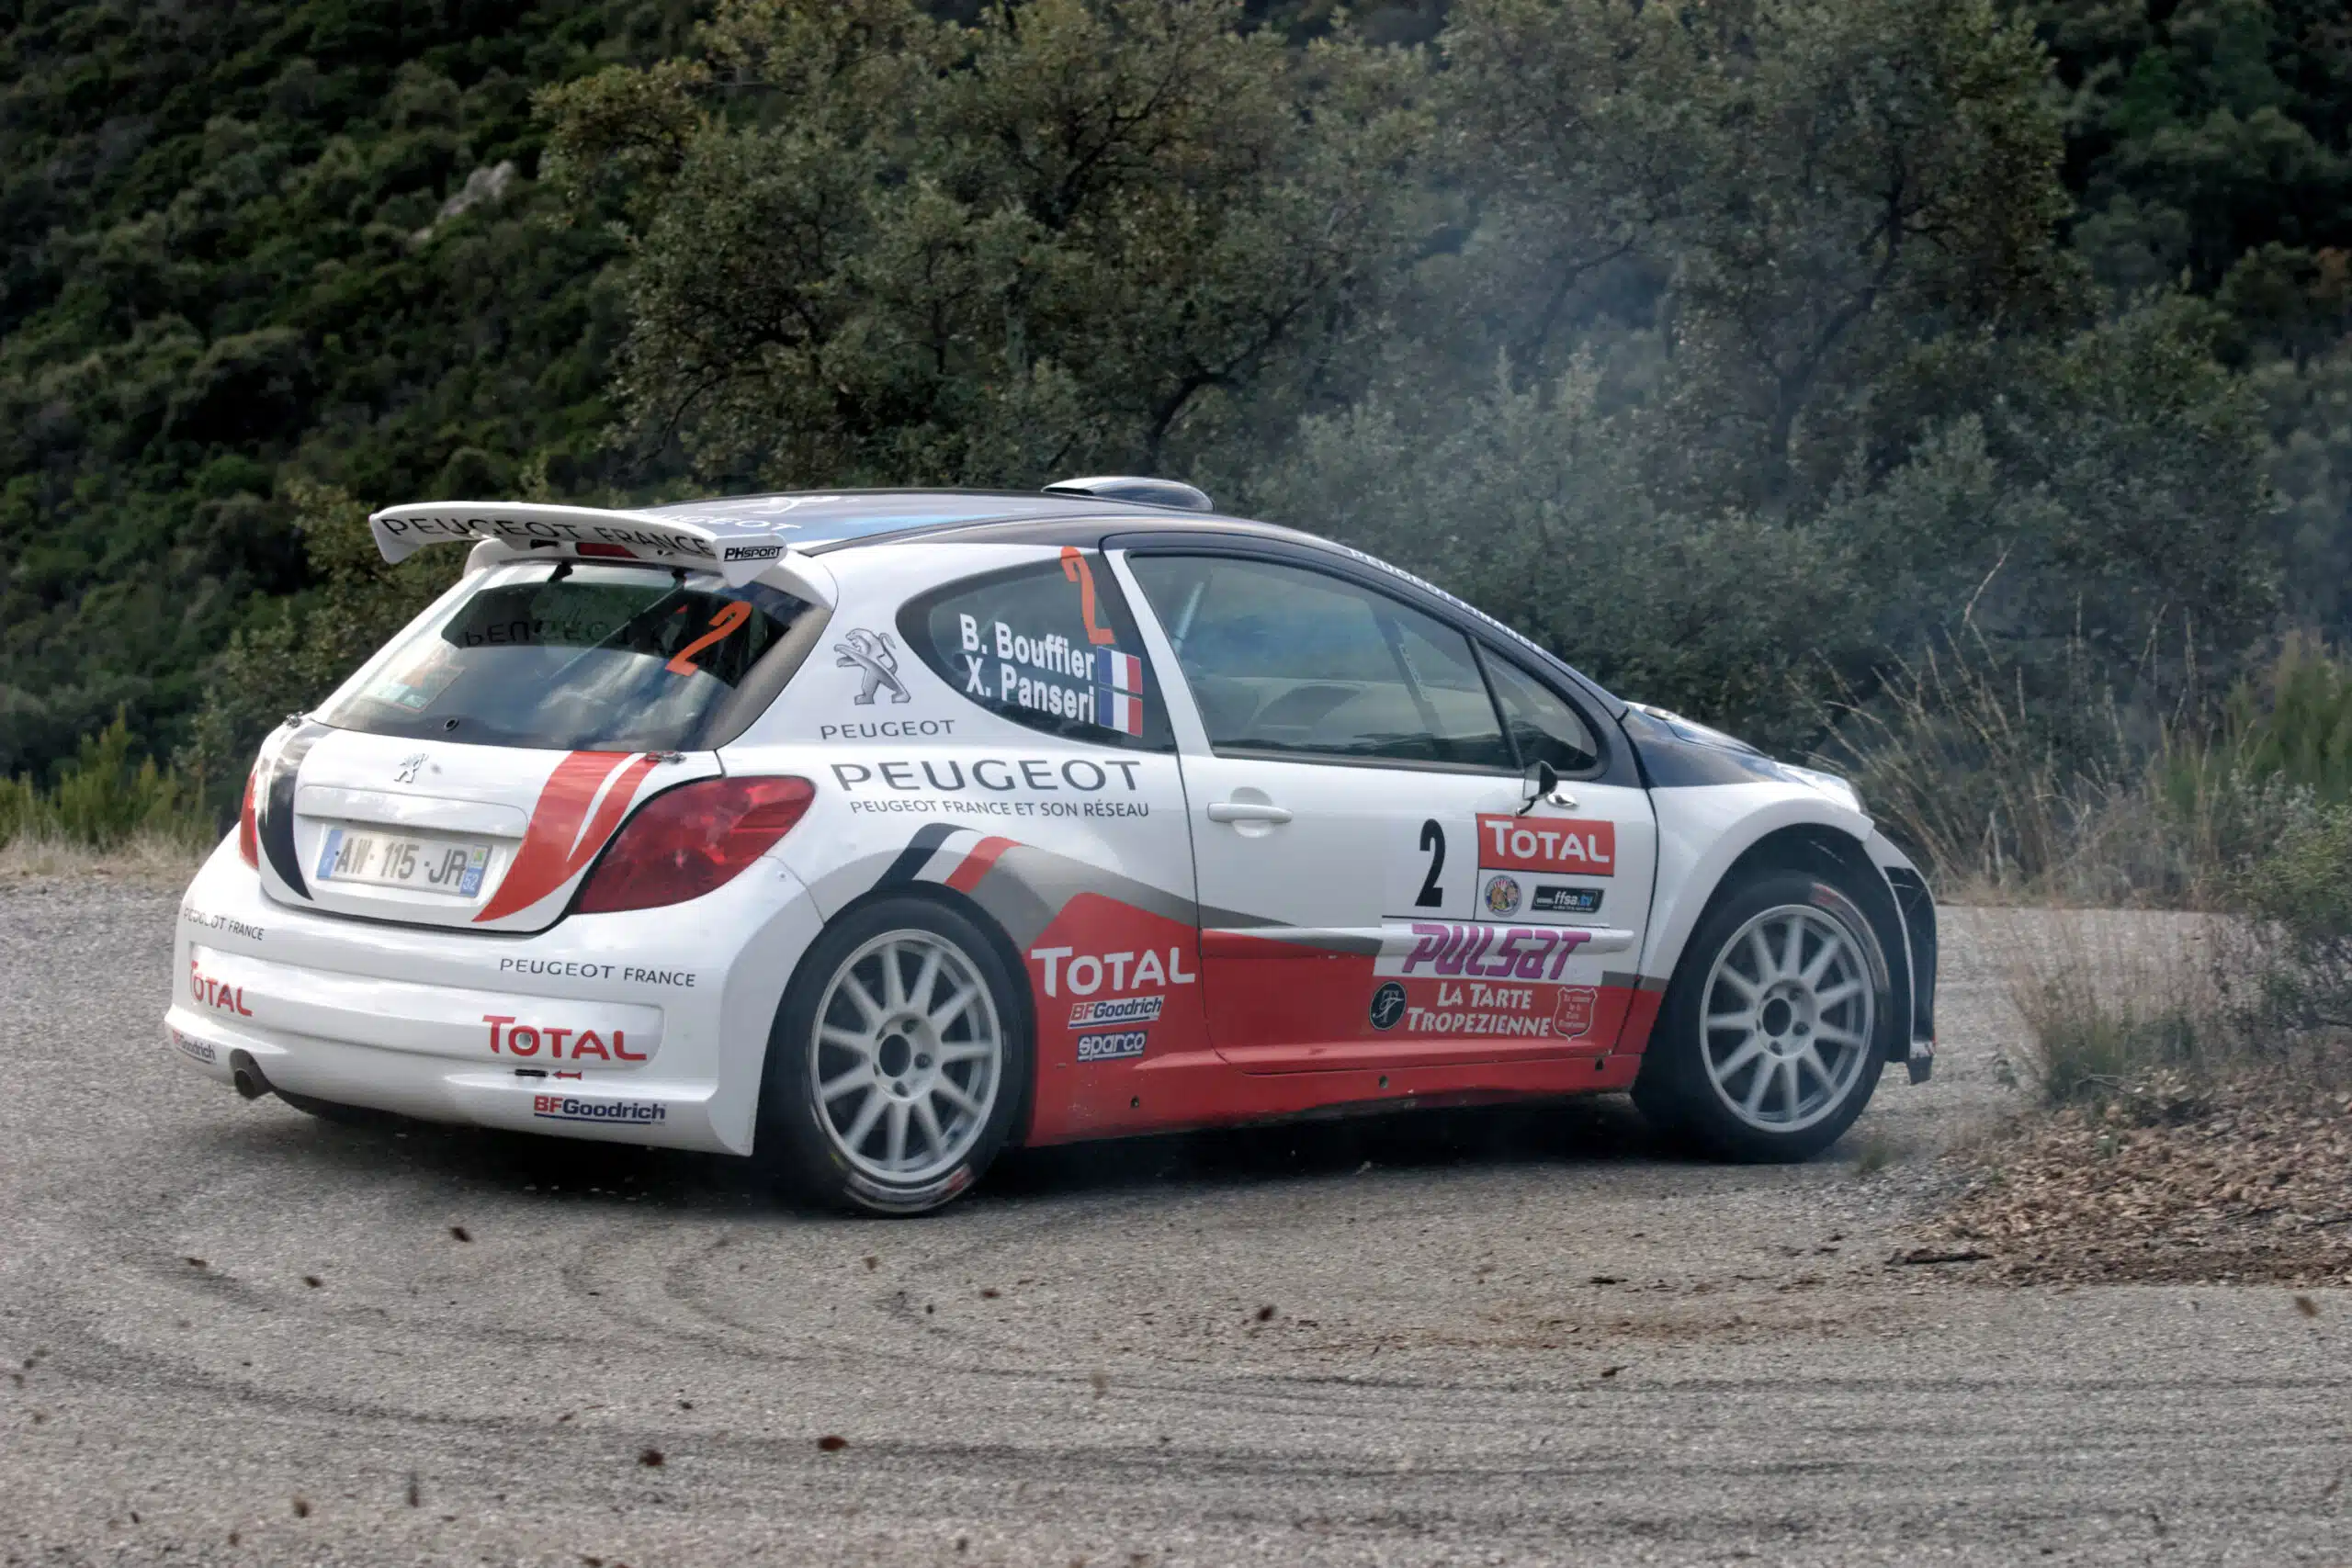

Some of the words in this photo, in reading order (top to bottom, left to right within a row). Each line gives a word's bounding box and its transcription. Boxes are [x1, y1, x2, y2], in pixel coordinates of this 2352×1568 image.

[380, 517, 581, 539] PEUGEOT
[595, 526, 717, 557] FRANCE
[1060, 546, 1116, 646] 2
[664, 600, 753, 677] 2
[959, 613, 988, 655] B.
[995, 621, 1095, 682] Bouffier
[964, 655, 991, 698] X.
[1001, 665, 1095, 725] Panseri
[820, 719, 956, 740] PEUGEOT
[831, 760, 1141, 792] PEUGEOT
[850, 799, 938, 815] PEUGEOT
[943, 800, 1012, 816] FRANCE
[1015, 802, 1035, 817] ET
[1041, 802, 1078, 818] SON
[1083, 797, 1149, 818] RÉSEAU
[1485, 819, 1610, 863] TOTAL
[1415, 818, 1446, 908] 2
[228, 919, 265, 941] FRANCE
[500, 958, 616, 980] PEUGEOT
[624, 967, 696, 987] FRANCE
[1031, 946, 1195, 998] TOTAL
[1070, 997, 1162, 1021] BFGoodrich
[1437, 981, 1464, 1008] LA
[1470, 983, 1533, 1010] TARTE
[481, 1014, 648, 1061] TOTAL
[1407, 1007, 1552, 1037] TROPEZIENNE
[1079, 1032, 1147, 1061] sparco
[533, 1094, 666, 1120] BFGoodrich
